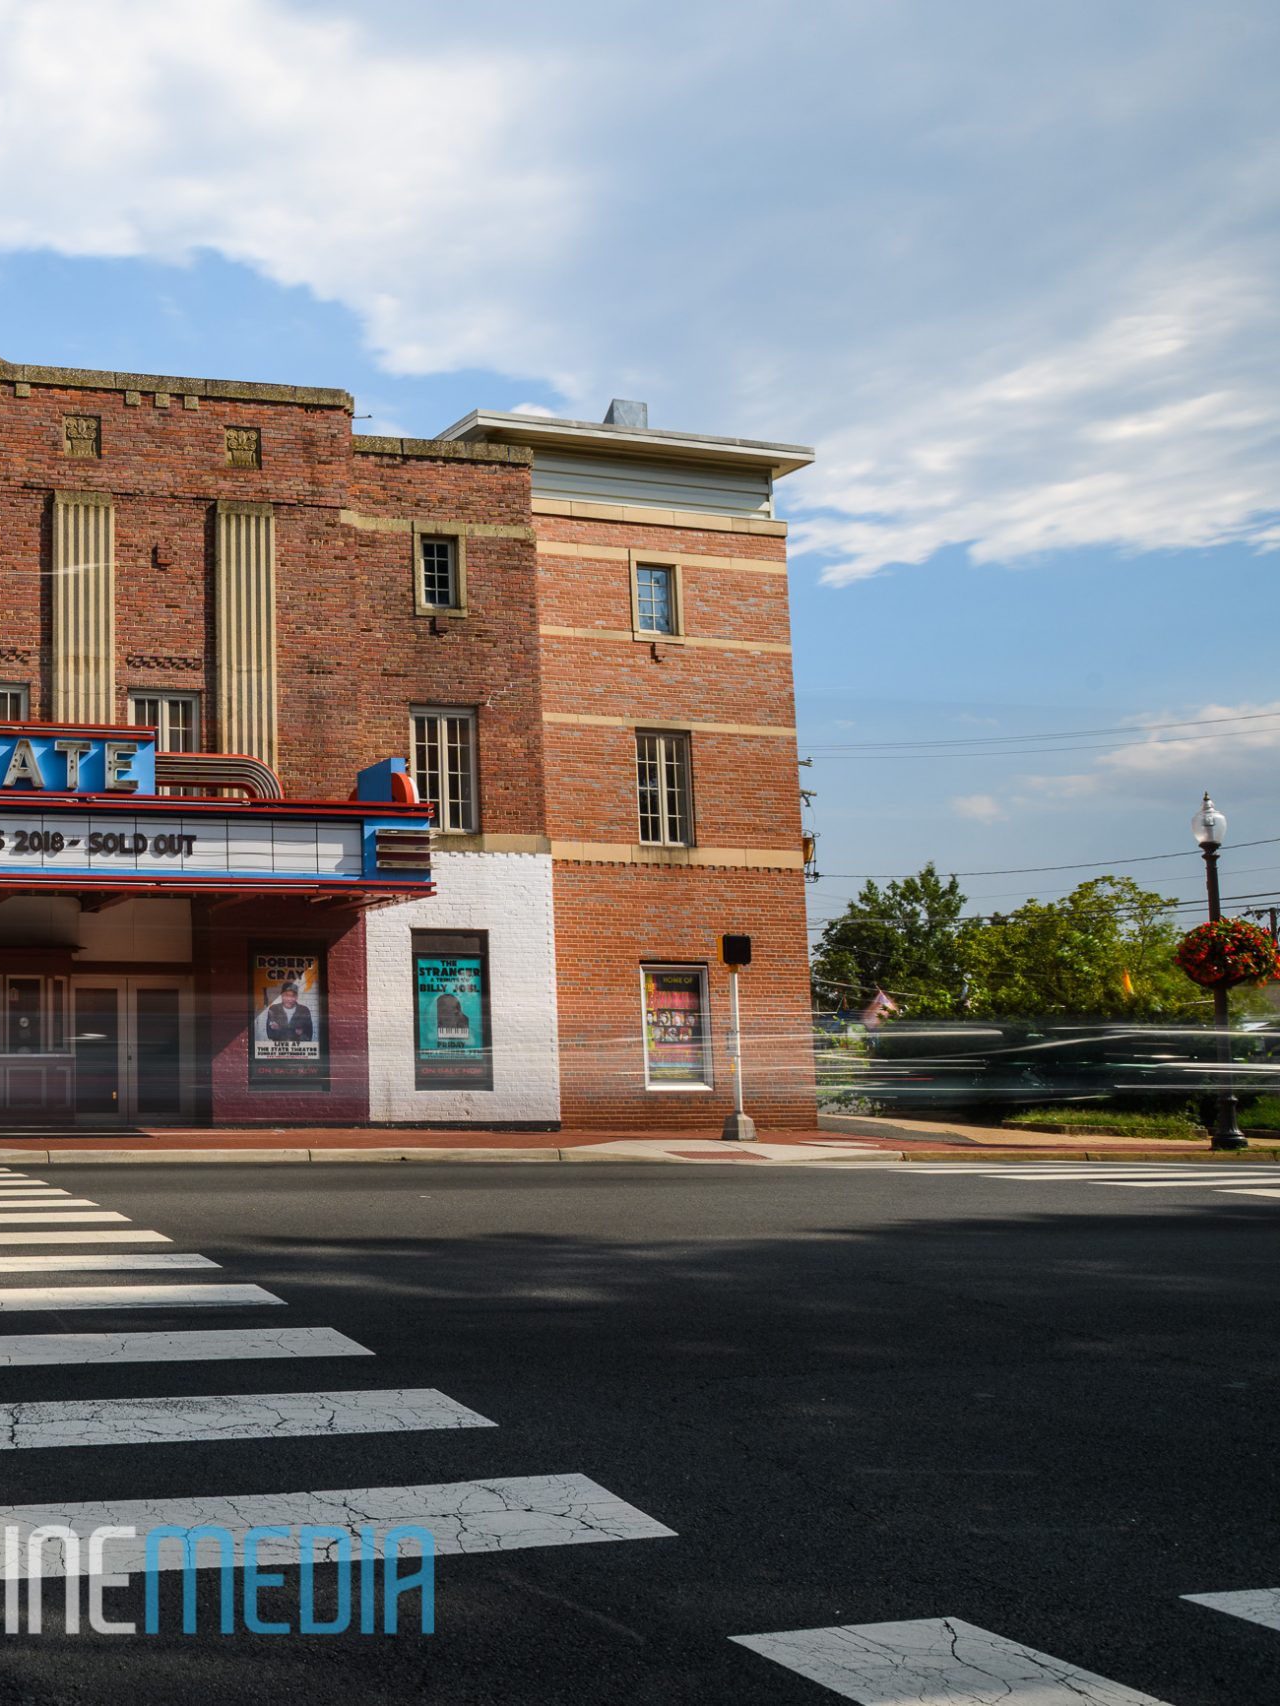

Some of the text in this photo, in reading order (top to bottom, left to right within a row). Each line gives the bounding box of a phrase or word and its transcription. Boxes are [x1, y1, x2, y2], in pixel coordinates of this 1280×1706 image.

[14, 830, 65, 853] 2018
[89, 831, 148, 854] SOLD
[154, 834, 197, 856] OUT
[257, 956, 315, 969] ROBERT
[267, 969, 305, 981] CRAY
[419, 967, 480, 977] STRANGER
[419, 984, 480, 993] BILLY JOEL
